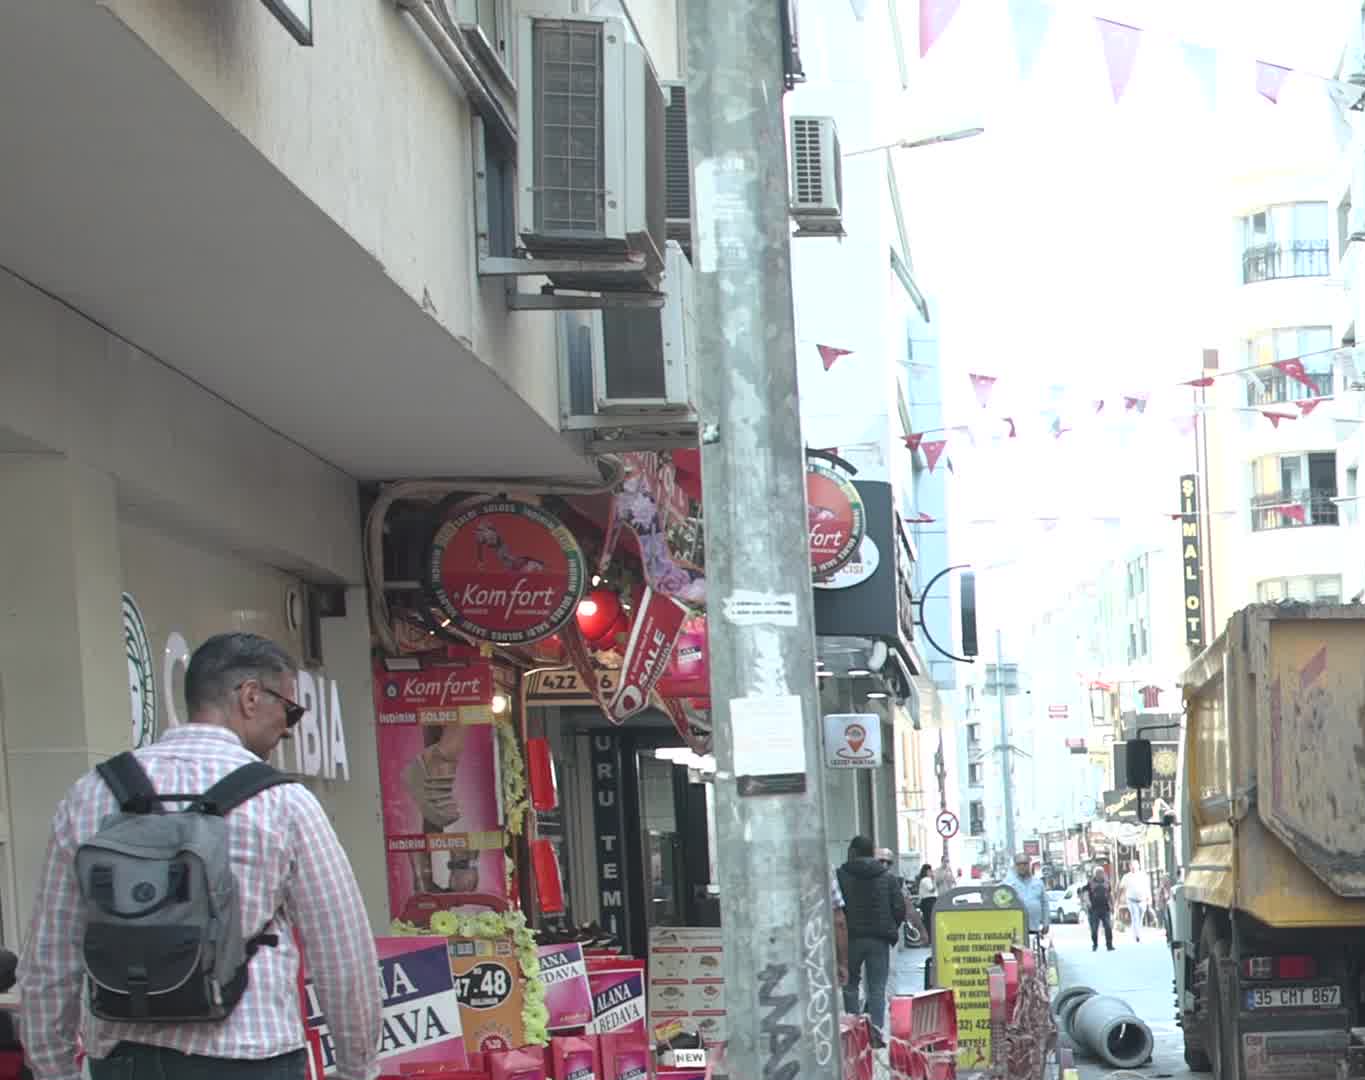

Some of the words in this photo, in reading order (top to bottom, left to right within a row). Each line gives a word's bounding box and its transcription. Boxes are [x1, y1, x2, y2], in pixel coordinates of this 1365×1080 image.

[809, 523, 843, 547] fort
[461, 578, 555, 620] Komfort
[638, 629, 667, 688] SALE
[402, 672, 481, 705] Komfort
[594, 735, 615, 807] URU
[541, 952, 568, 970] ANA
[1255, 990, 1273, 1005] 35
[676, 1053, 703, 1062] NEW
